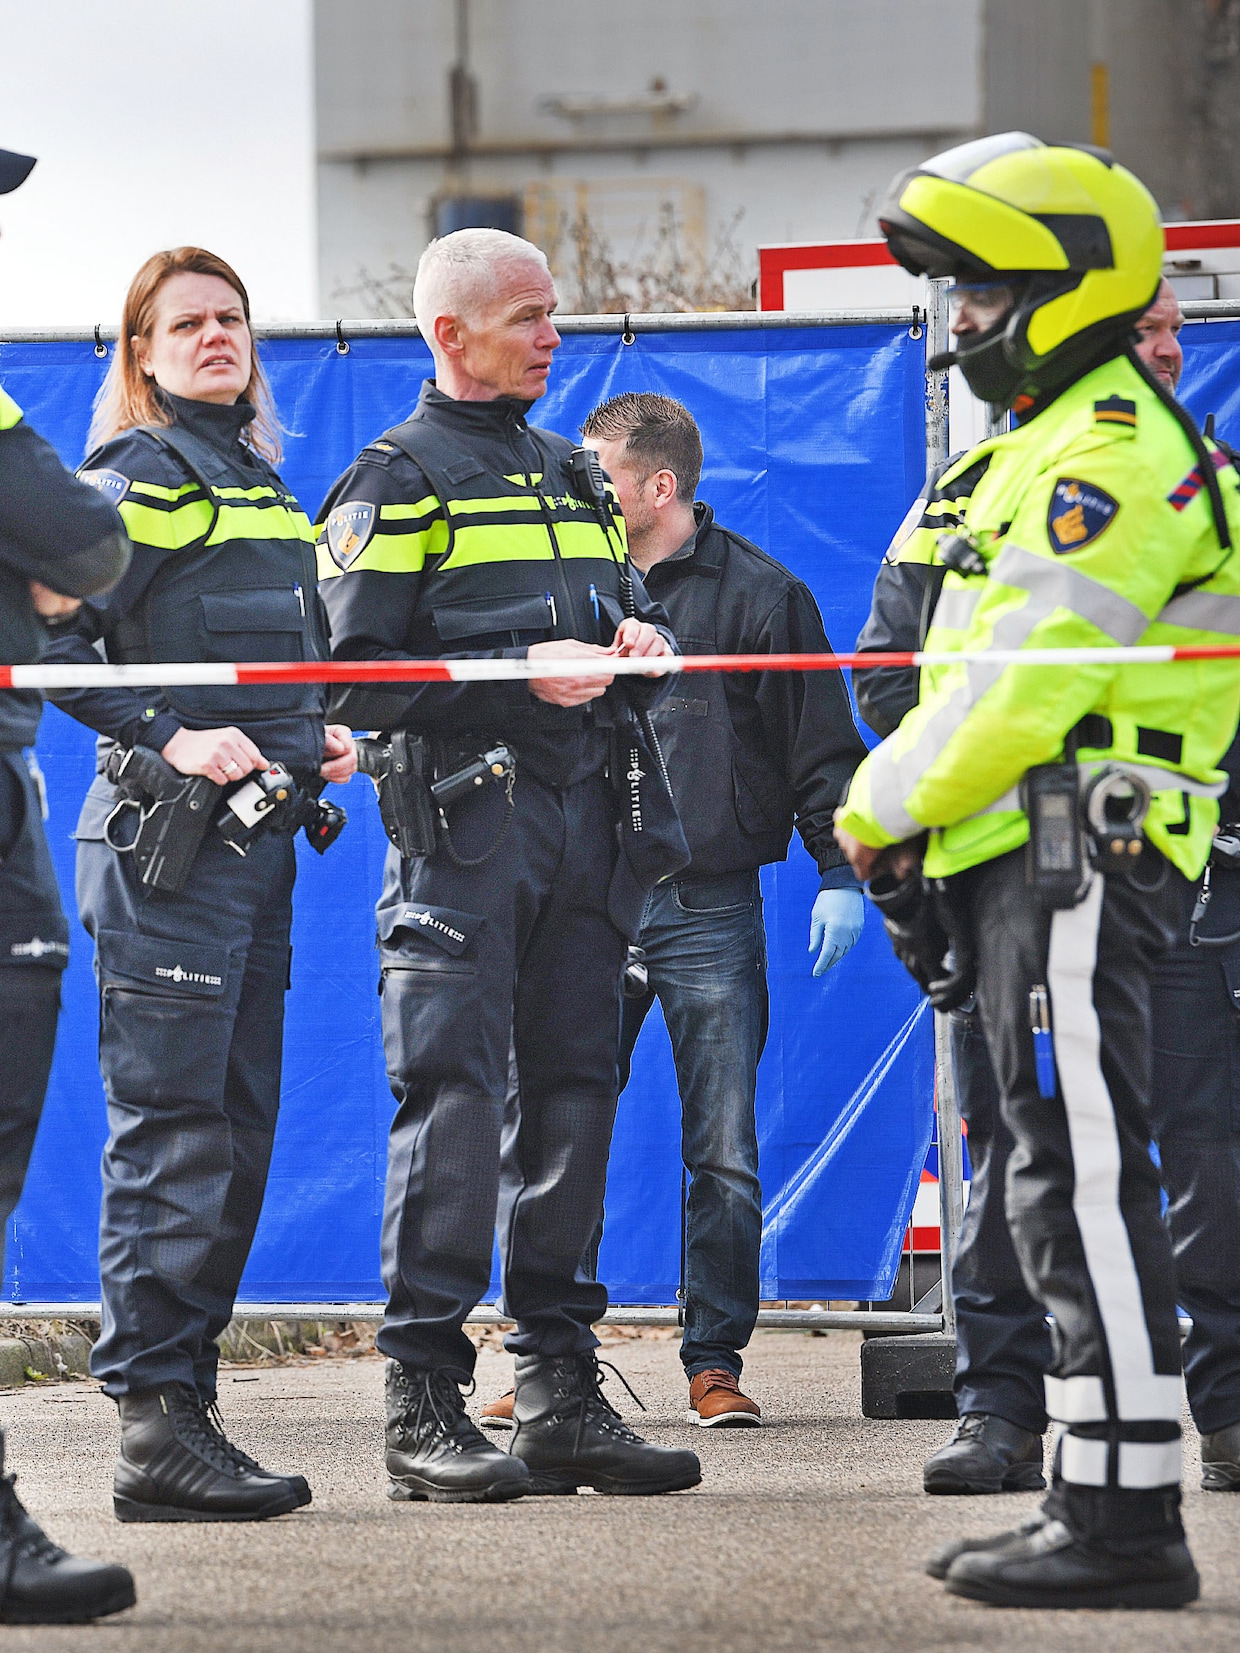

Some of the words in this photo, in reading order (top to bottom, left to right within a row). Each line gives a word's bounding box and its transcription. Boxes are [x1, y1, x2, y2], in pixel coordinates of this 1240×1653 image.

[330, 510, 369, 527] POLITIE
[627, 762, 646, 818] POLITIE
[415, 911, 456, 938] POLITIE
[167, 965, 211, 985] POLITIE
